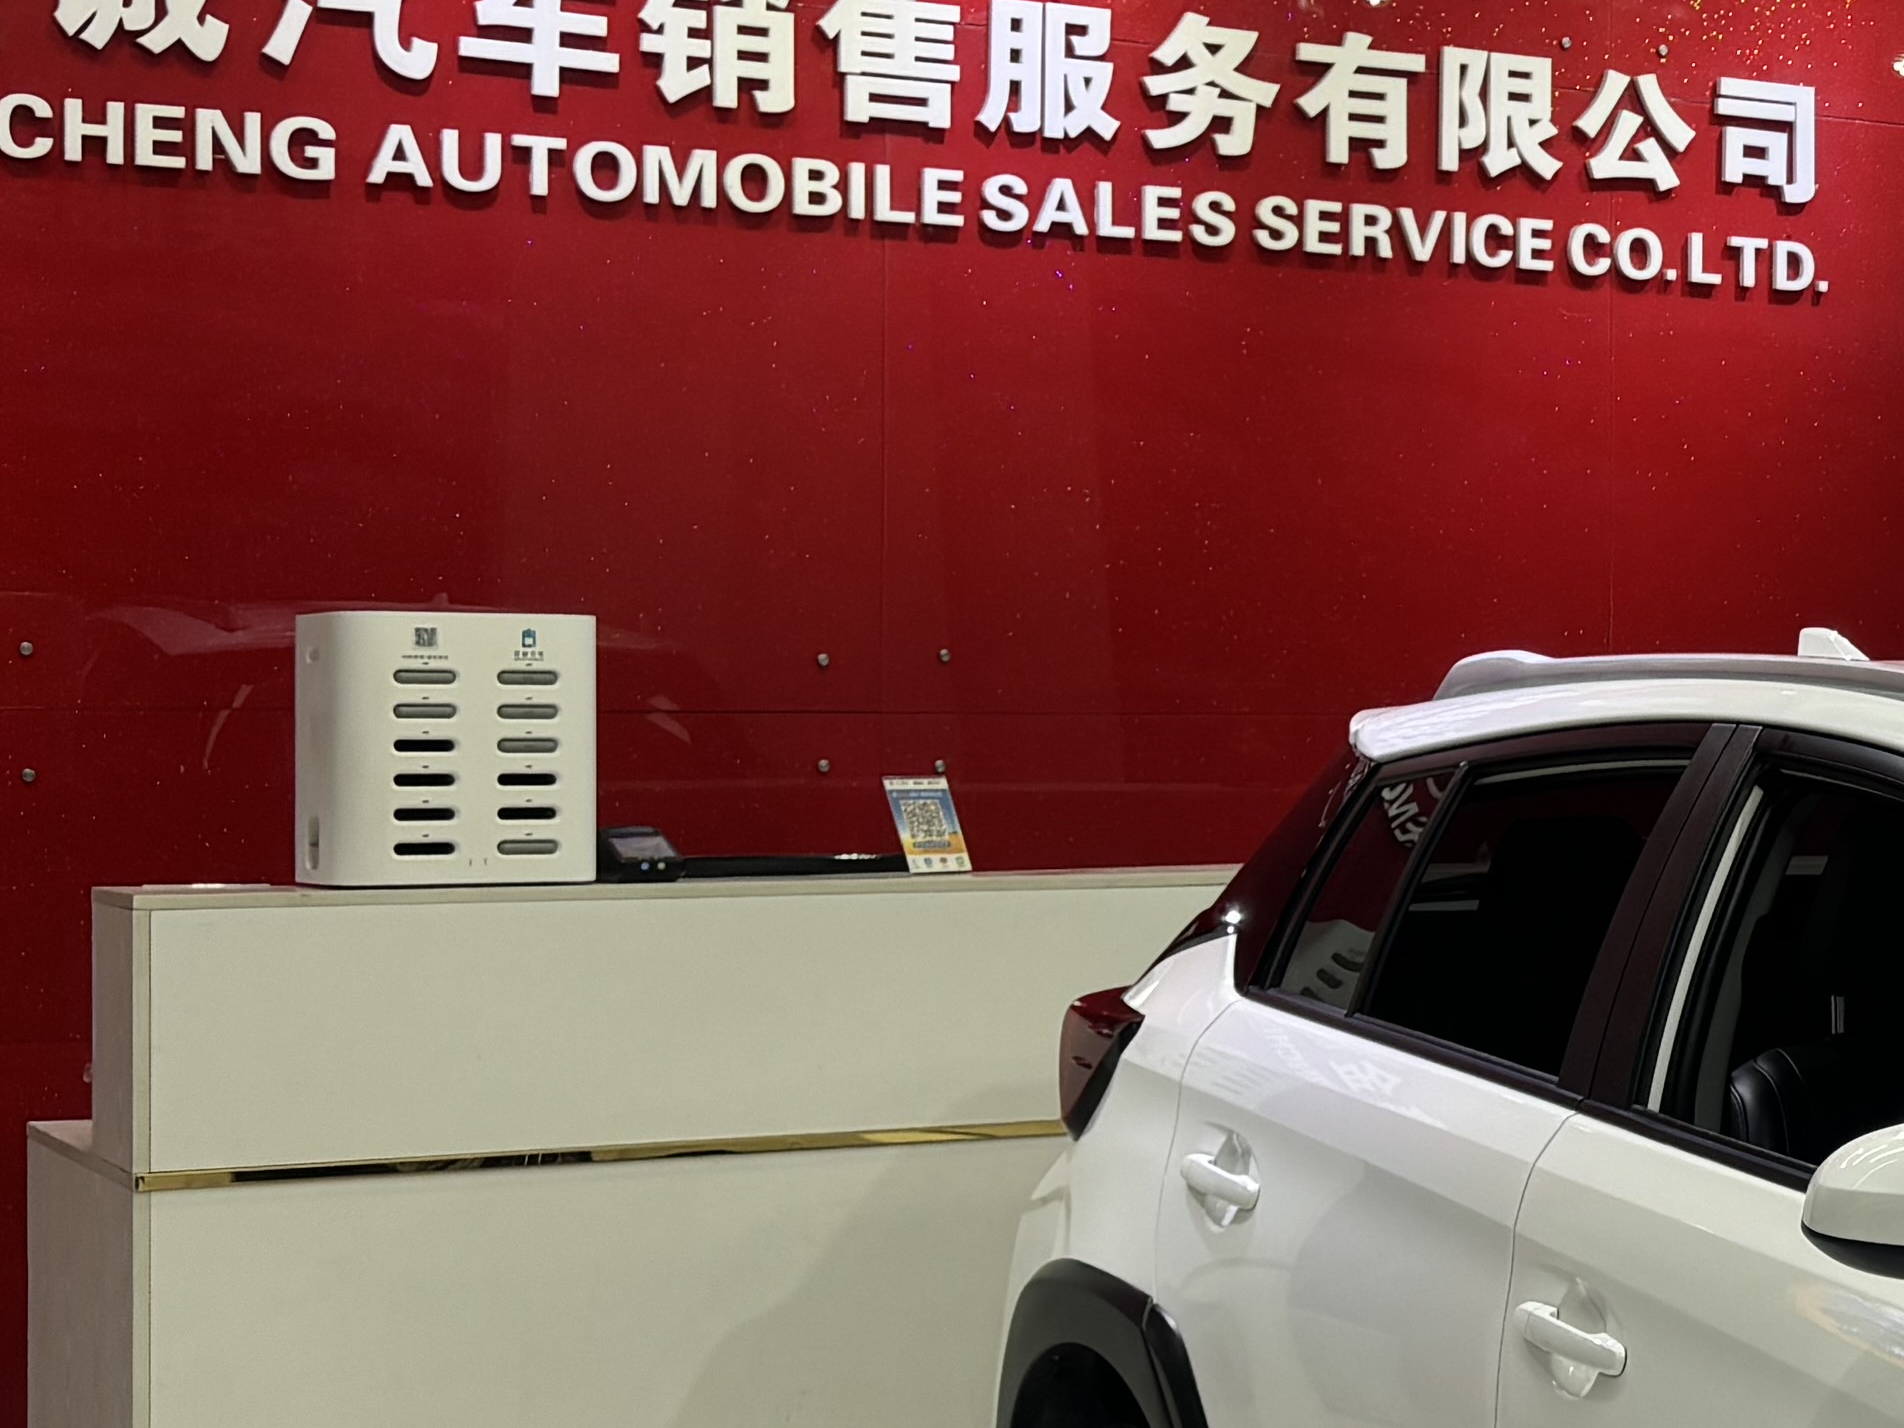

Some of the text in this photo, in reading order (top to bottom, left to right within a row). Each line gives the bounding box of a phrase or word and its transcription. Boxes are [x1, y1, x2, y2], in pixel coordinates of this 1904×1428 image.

[0, 93, 336, 182] CHENG
[366, 124, 964, 228] AUTOMOBILE
[980, 173, 1237, 248] SALES
[1252, 195, 1554, 273] SERVICE
